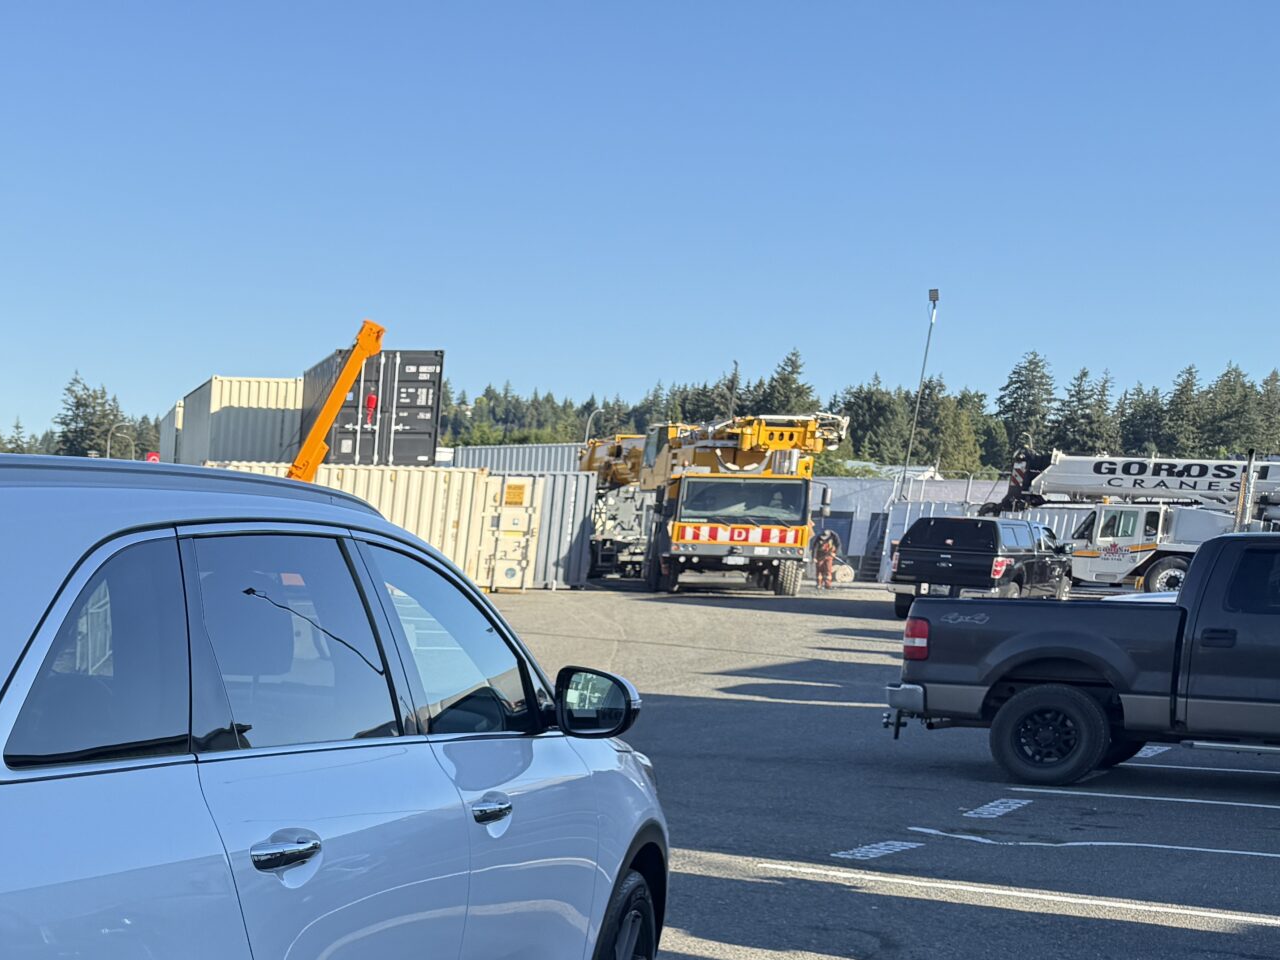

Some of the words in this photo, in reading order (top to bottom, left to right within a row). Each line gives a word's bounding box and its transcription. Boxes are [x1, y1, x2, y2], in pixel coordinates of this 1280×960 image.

[1093, 461, 1270, 480] GOROSH
[1107, 478, 1240, 492] CRANES
[733, 529, 747, 540] D
